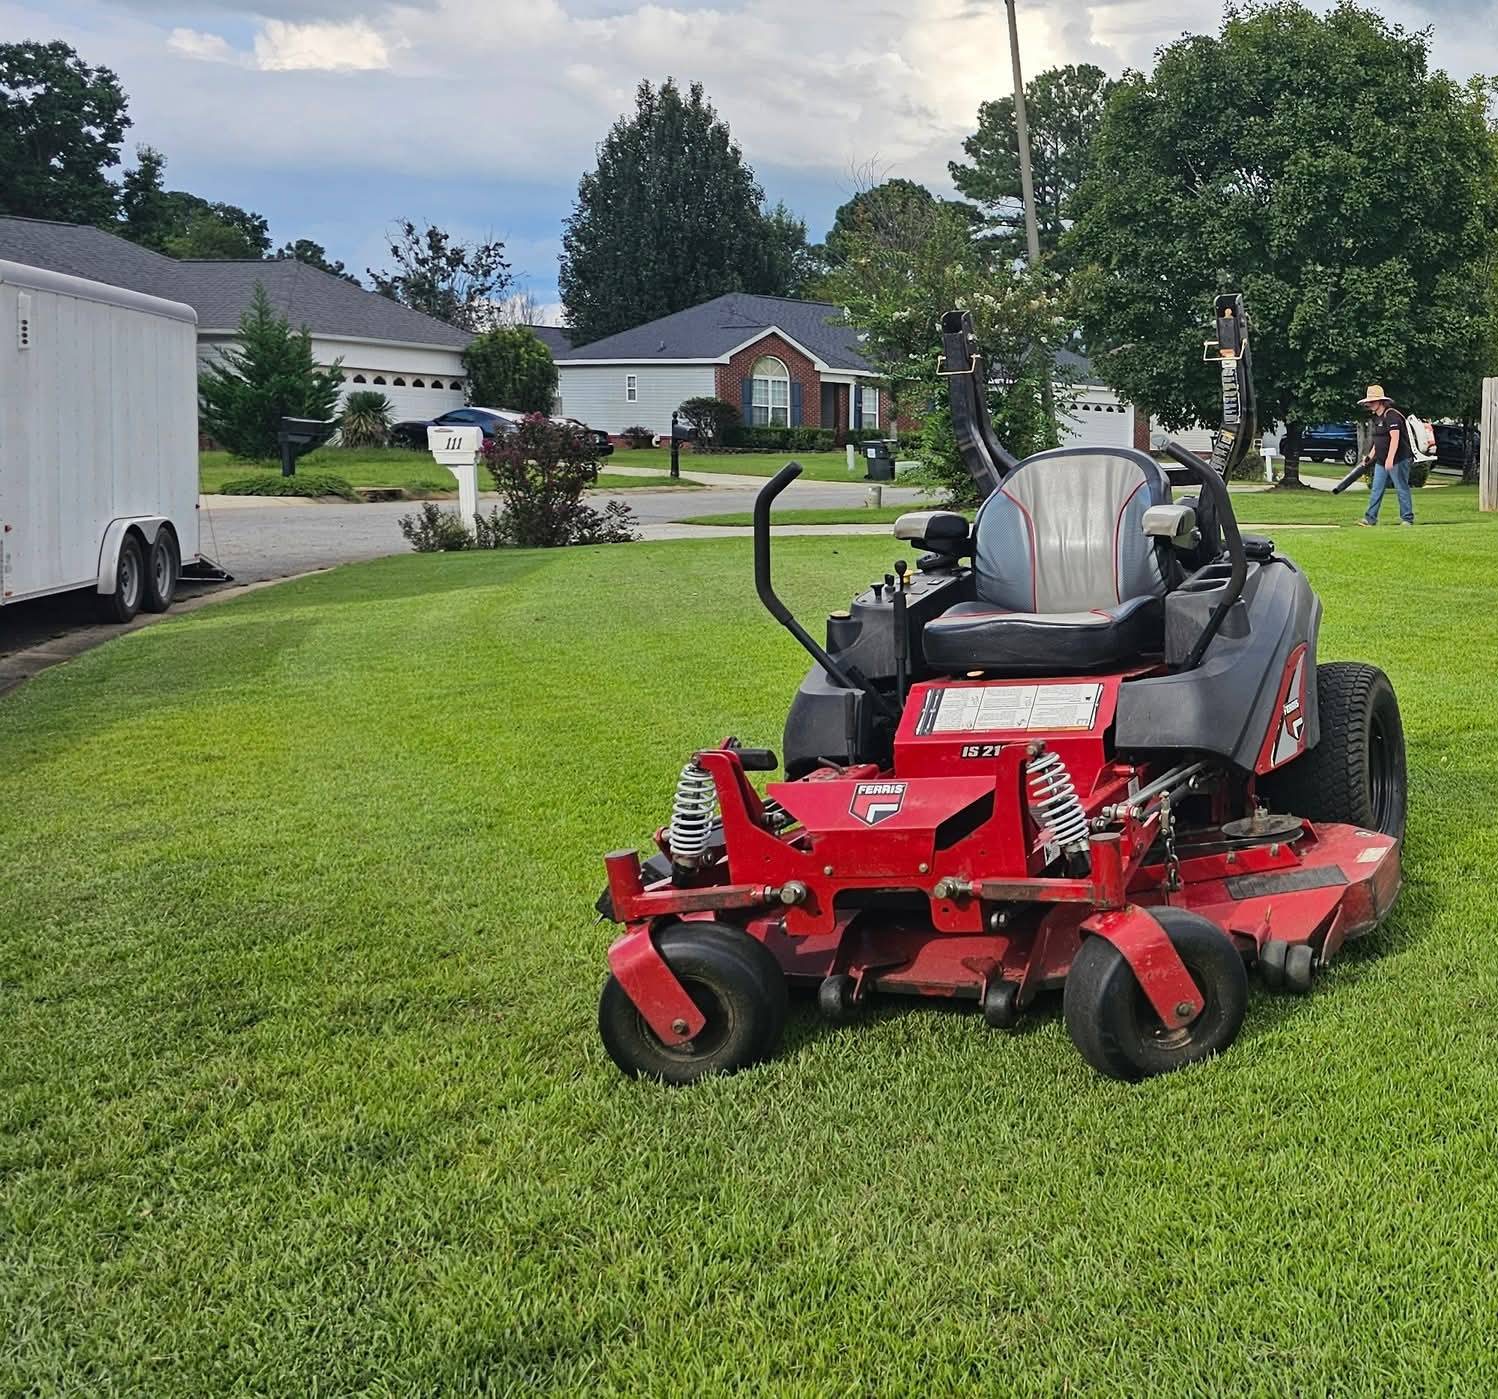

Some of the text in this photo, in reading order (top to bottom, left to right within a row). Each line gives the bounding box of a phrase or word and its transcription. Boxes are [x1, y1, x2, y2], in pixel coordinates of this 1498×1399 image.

[445, 437, 463, 450] 111
[962, 744, 1002, 758] IS 21
[858, 784, 904, 795] FERRIS
